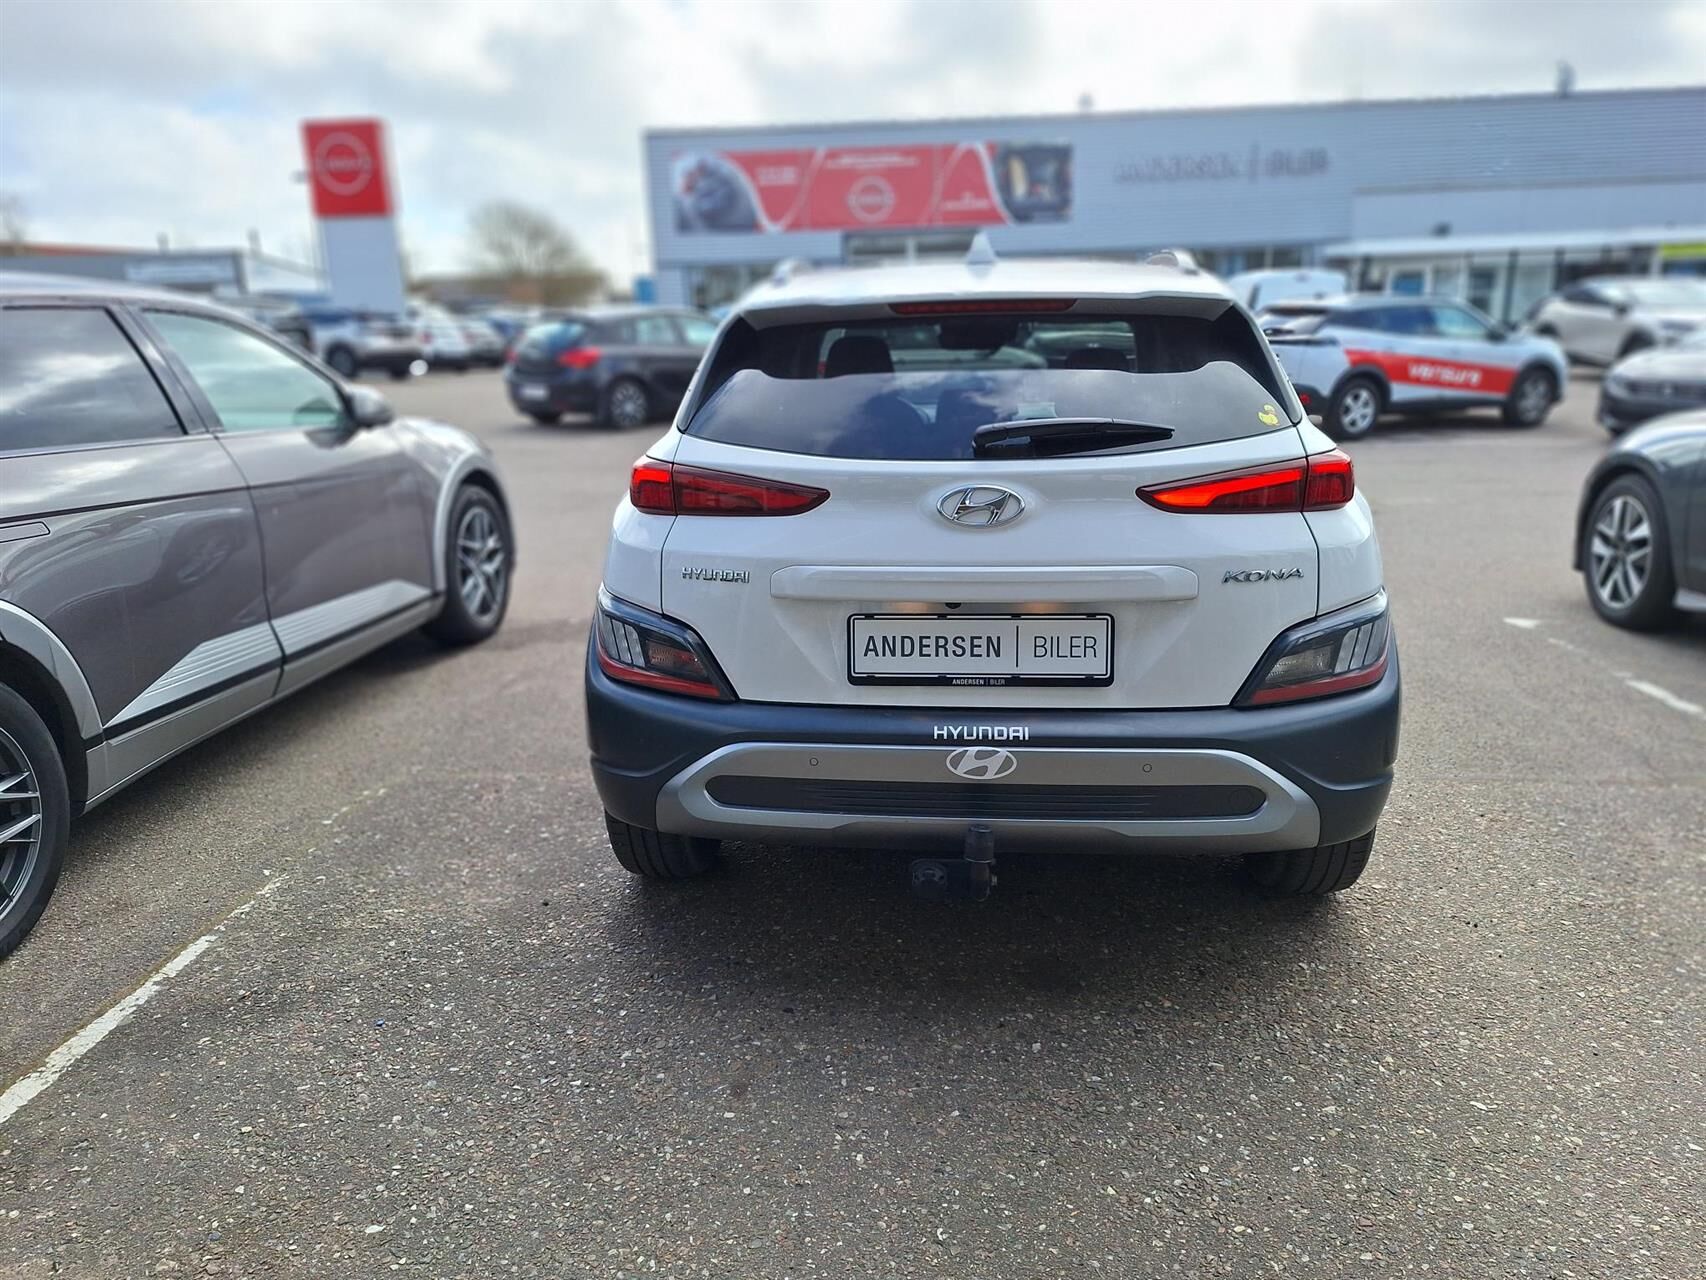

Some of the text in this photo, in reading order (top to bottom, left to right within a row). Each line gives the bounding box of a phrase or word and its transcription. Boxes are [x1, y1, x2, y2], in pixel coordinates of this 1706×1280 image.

[682, 567, 750, 583] HYUNDAI
[1222, 567, 1304, 583] KONA
[863, 635, 1097, 659] ANDERSEN BILER
[933, 725, 1029, 741] HYUNDAI
